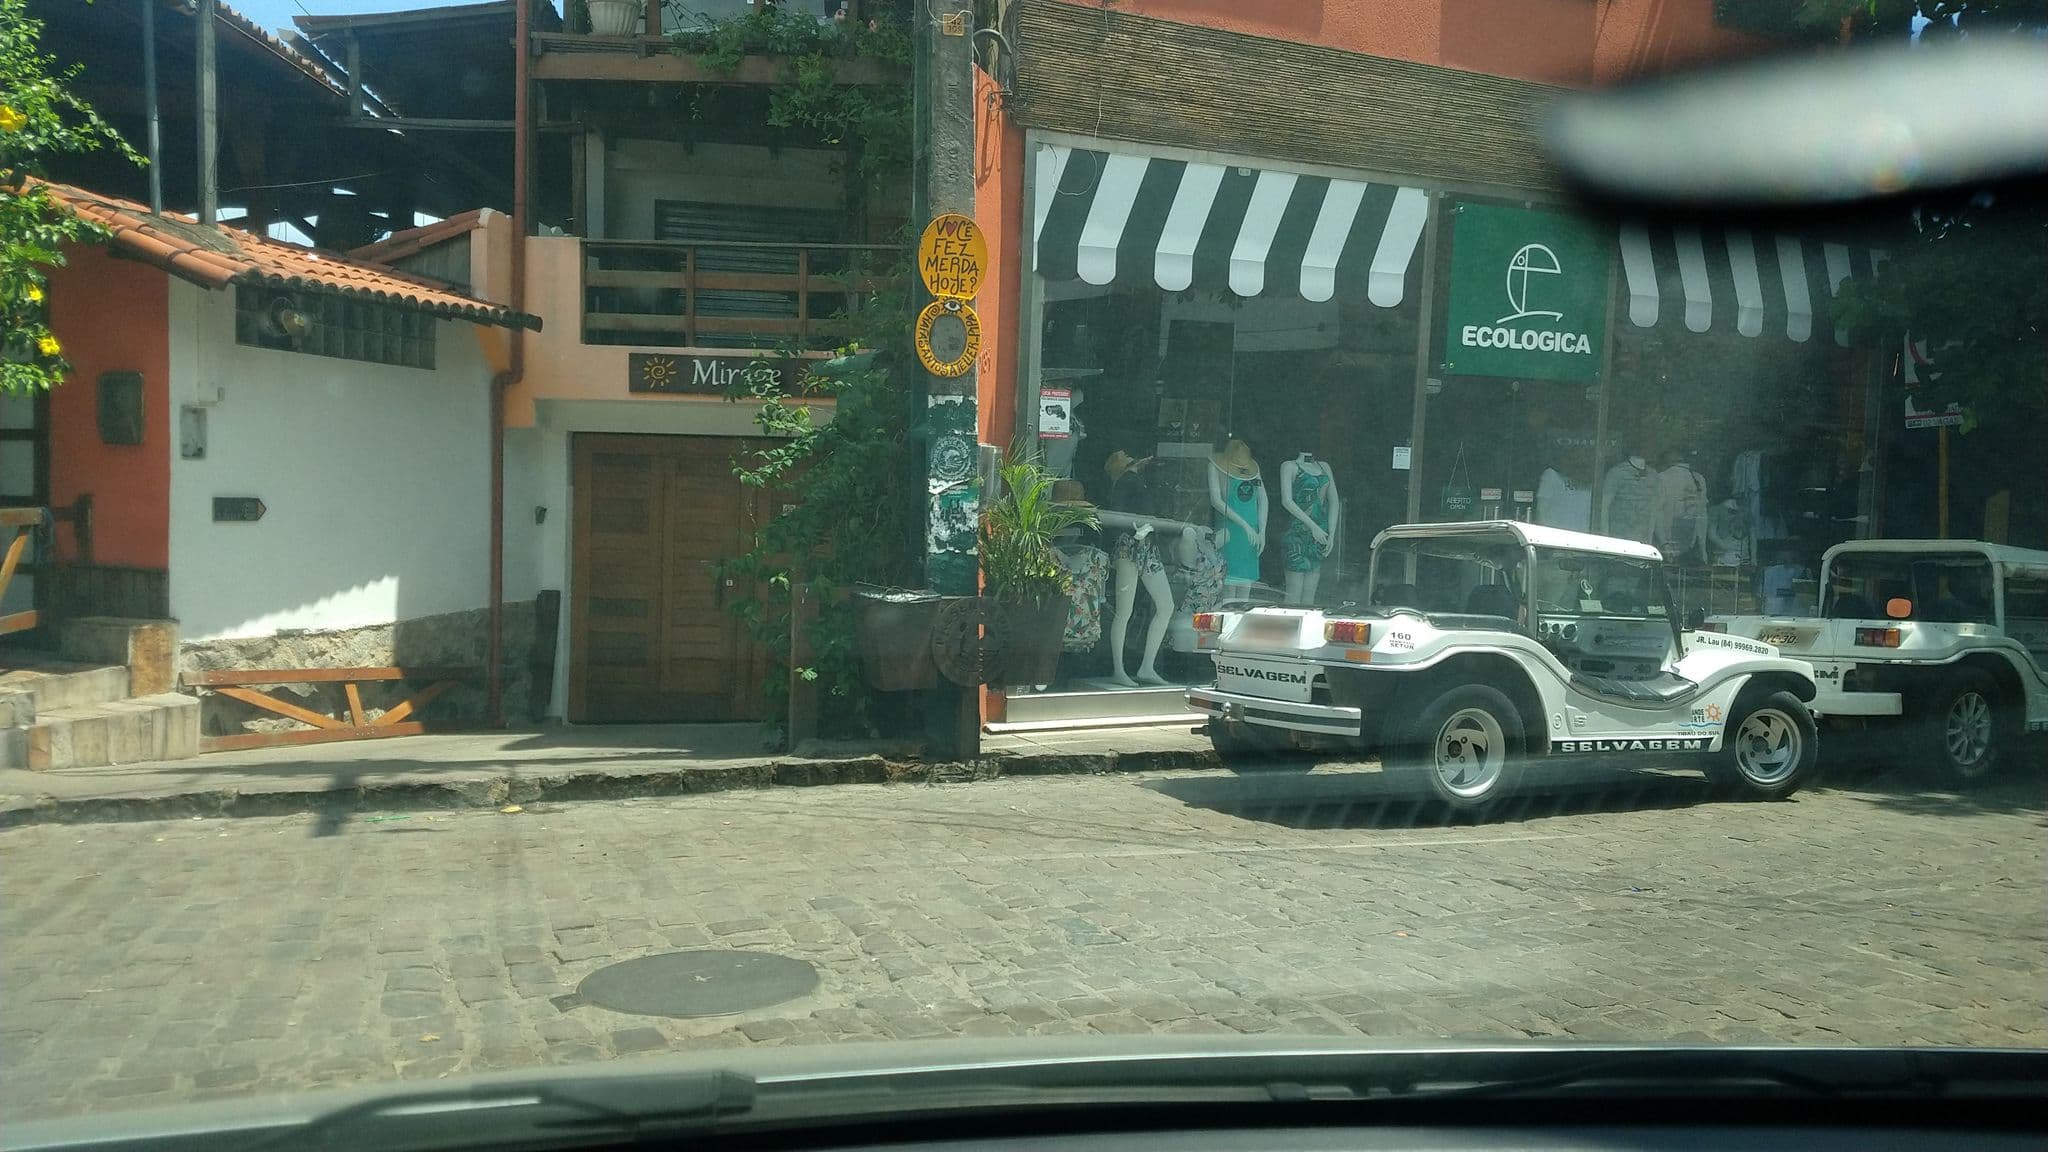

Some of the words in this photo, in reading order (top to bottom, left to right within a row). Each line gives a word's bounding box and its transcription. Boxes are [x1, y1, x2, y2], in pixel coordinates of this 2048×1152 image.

[933, 237, 975, 257] FEZ
[925, 255, 980, 277] MERDA
[930, 273, 978, 295] HOJE?
[1462, 325, 1592, 354] ECOLOGICA
[1446, 497, 1472, 505] ABERTO
[1391, 632, 1412, 641] 160
[1708, 636, 1720, 646] Lau
[1720, 638, 1733, 649] (84)
[1217, 664, 1307, 684] SELVAGEM
[1561, 740, 1702, 752] SELVAGEM
